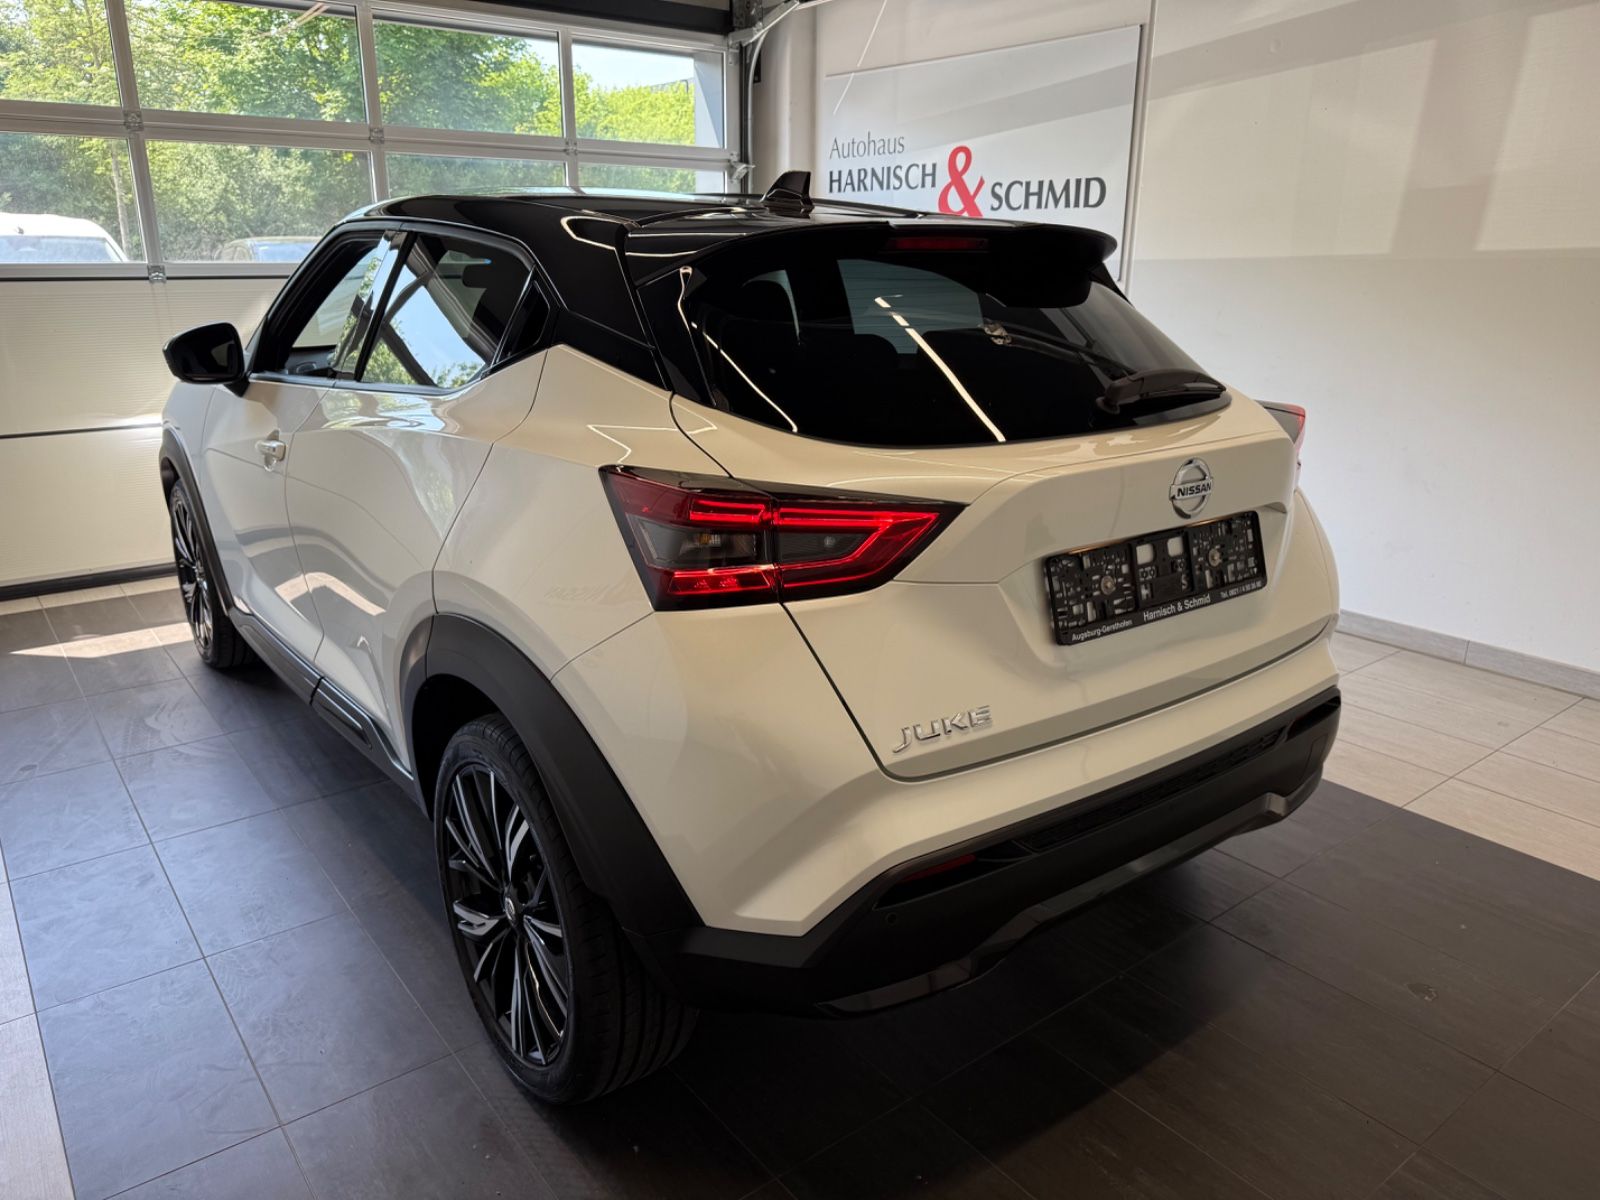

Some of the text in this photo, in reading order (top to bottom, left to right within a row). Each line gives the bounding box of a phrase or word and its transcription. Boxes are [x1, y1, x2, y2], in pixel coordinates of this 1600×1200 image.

[829, 131, 905, 160] Autohaus
[828, 145, 1108, 218] HARNISCH & SCHMID
[1176, 482, 1212, 498] NISSAN
[1143, 603, 1177, 622] Harnisch
[1176, 601, 1184, 613] &
[1184, 593, 1212, 610] Schmid
[892, 705, 993, 754] JUKE
